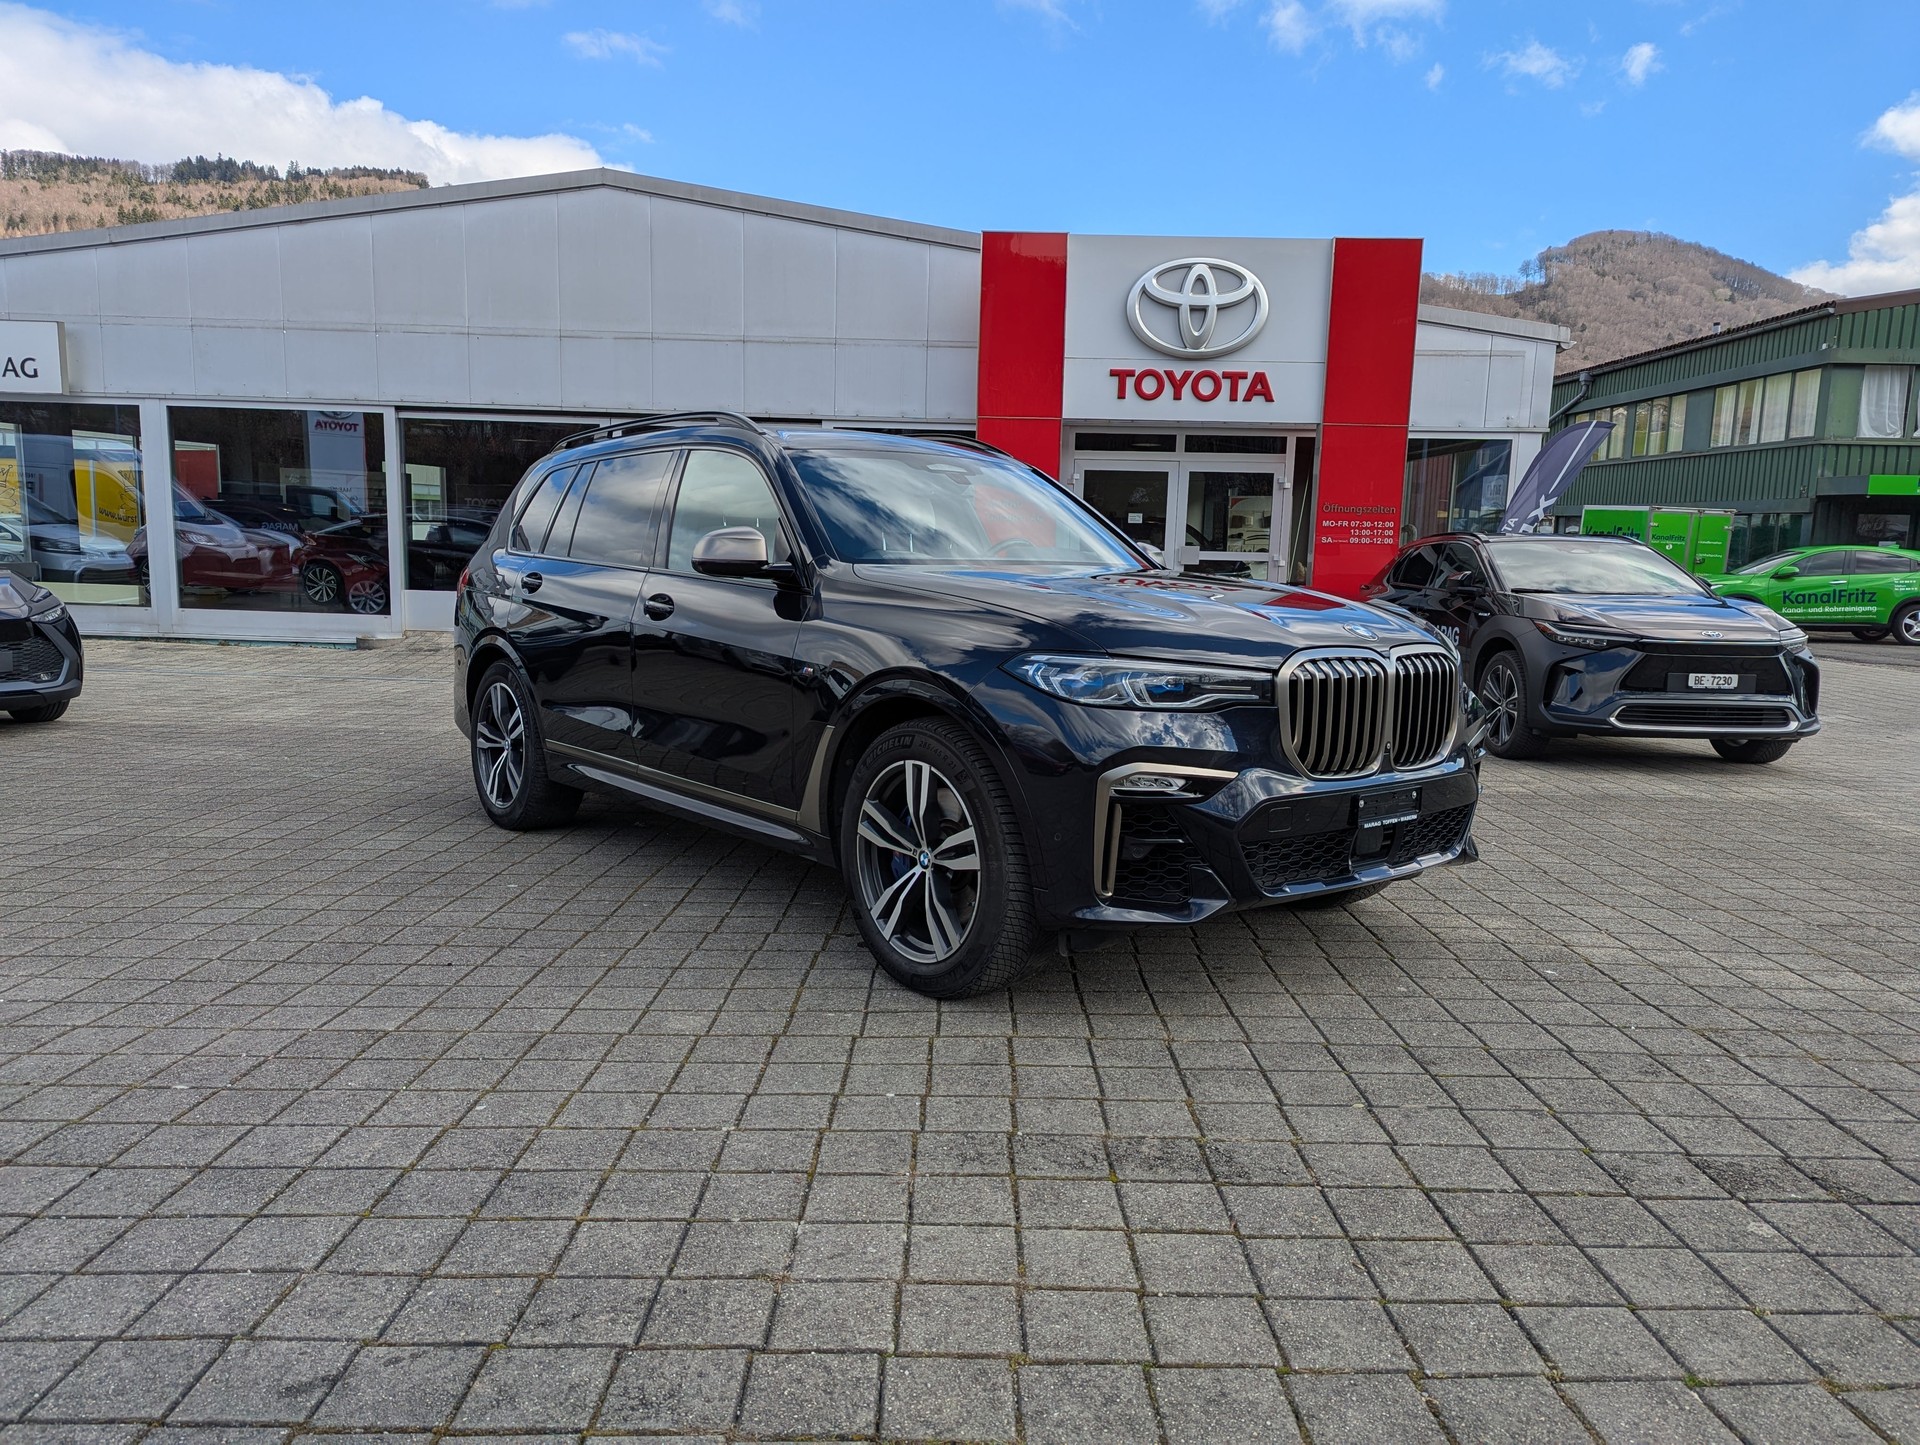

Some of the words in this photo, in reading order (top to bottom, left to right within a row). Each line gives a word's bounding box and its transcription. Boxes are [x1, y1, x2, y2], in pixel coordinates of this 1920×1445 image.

[2, 356, 39, 378] AG
[1109, 368, 1275, 402] TOYOTA
[1323, 502, 1396, 515] Öffnungszeiten
[1651, 534, 1685, 542] KanalFritz
[1782, 588, 1877, 604] KanalFritz
[1824, 605, 1877, 613] Rohrreinigung
[866, 736, 913, 766] MICHELIN
[919, 740, 943, 757] 285/45
